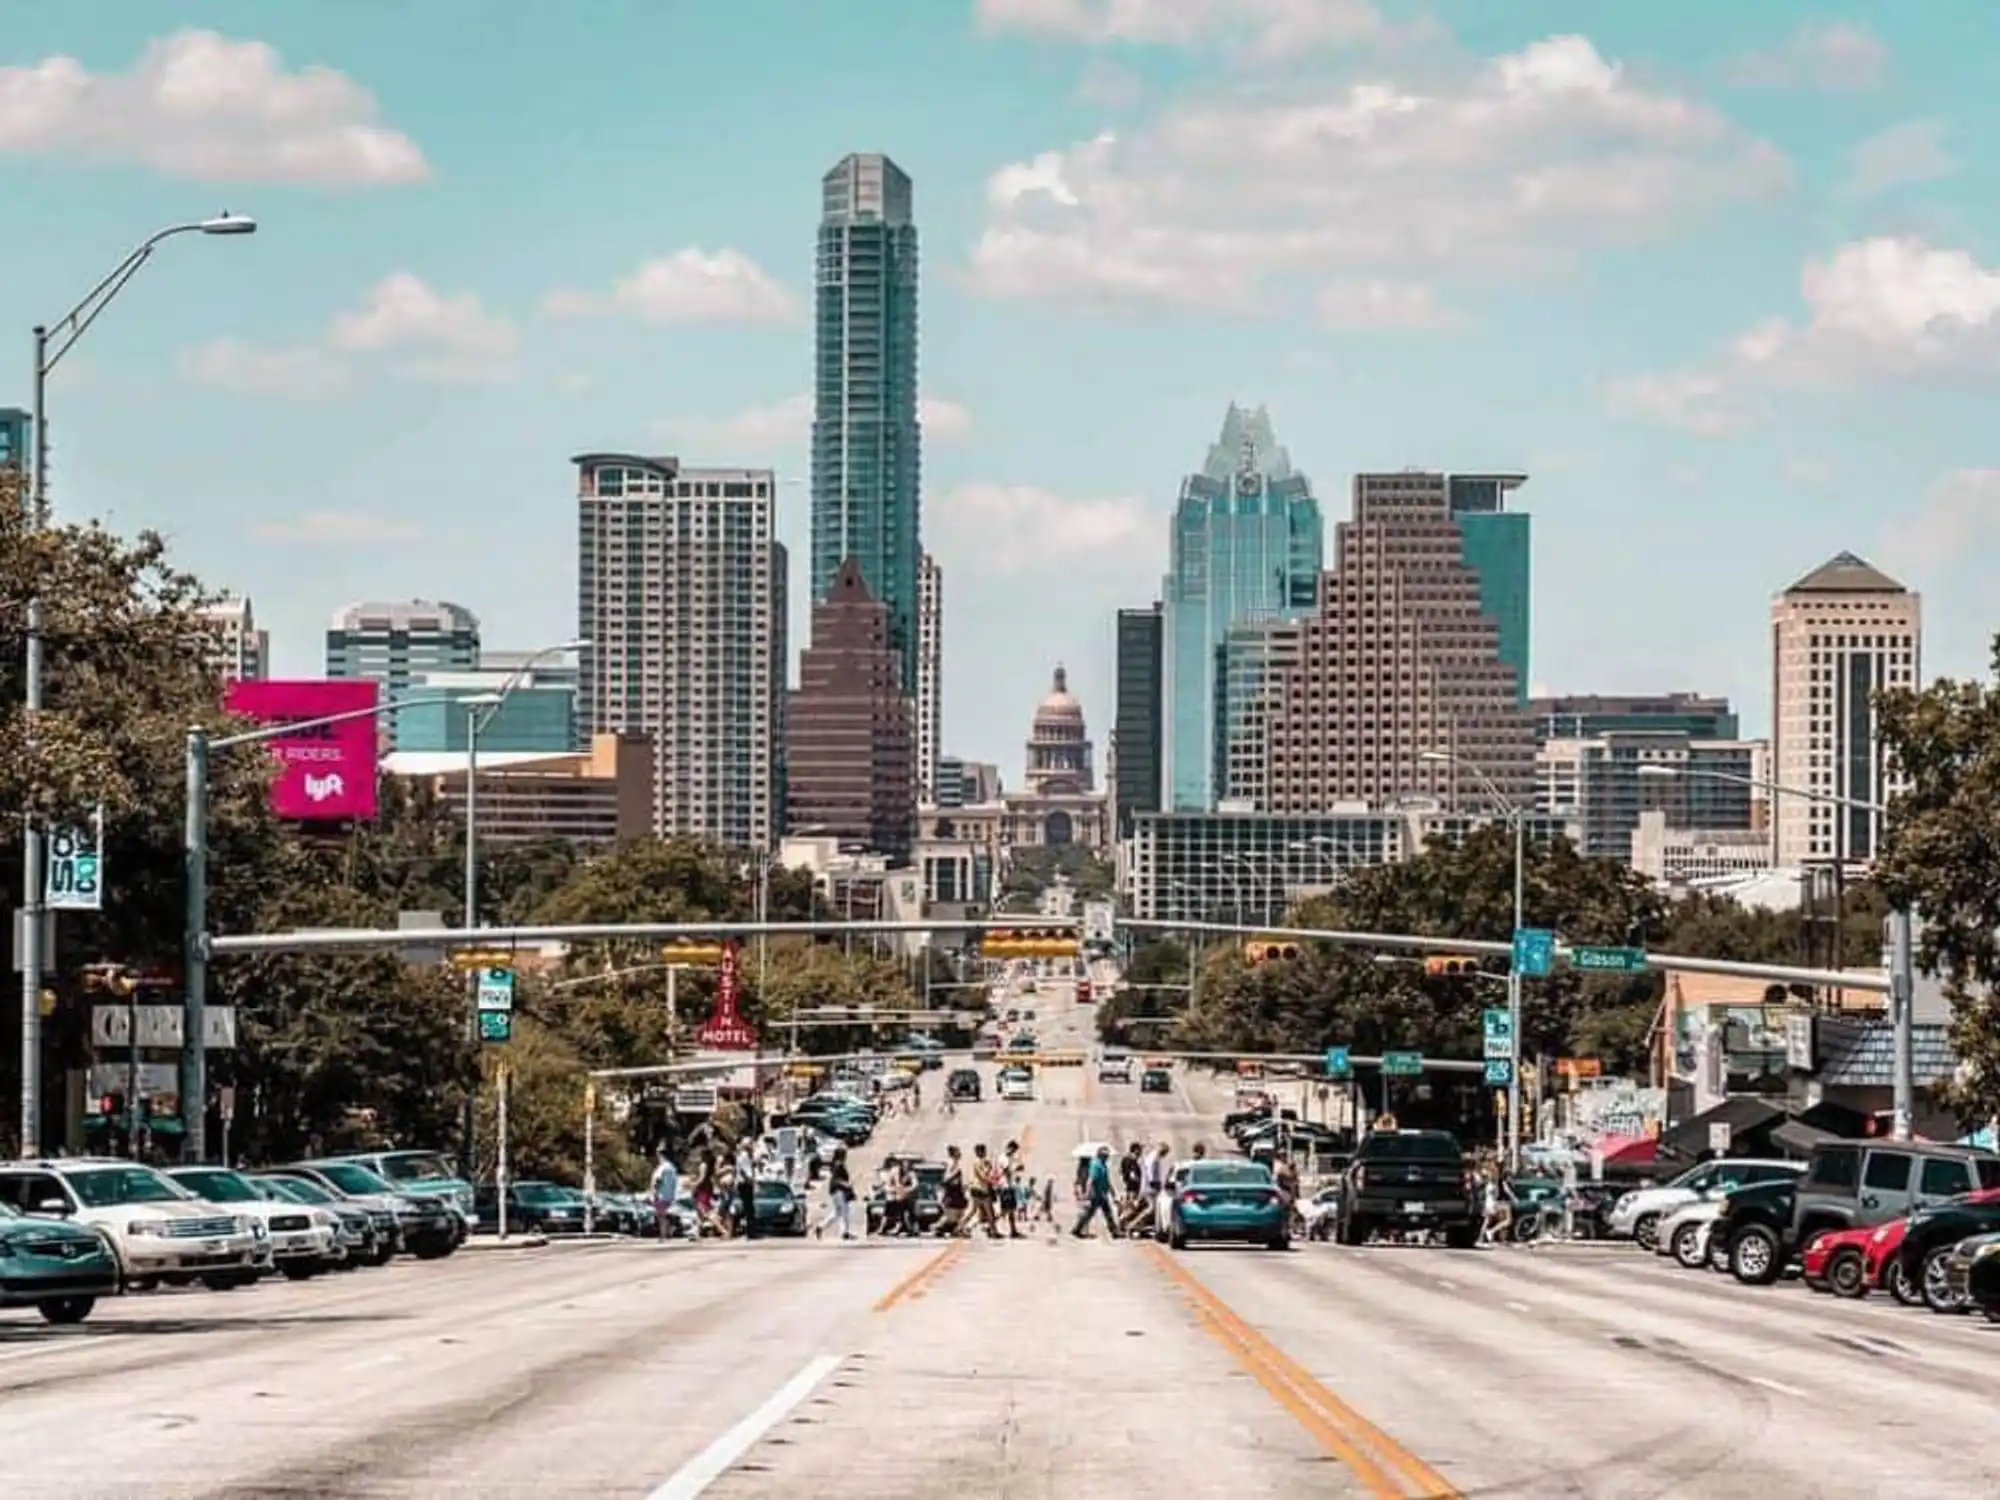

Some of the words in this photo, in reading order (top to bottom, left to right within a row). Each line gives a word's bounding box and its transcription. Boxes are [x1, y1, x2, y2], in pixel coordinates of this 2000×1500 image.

[304, 773, 344, 801] lyft
[1580, 950, 1626, 967] Gibson
[721, 948, 734, 1026] AUSTIN
[702, 1030, 751, 1043] MOTEL
